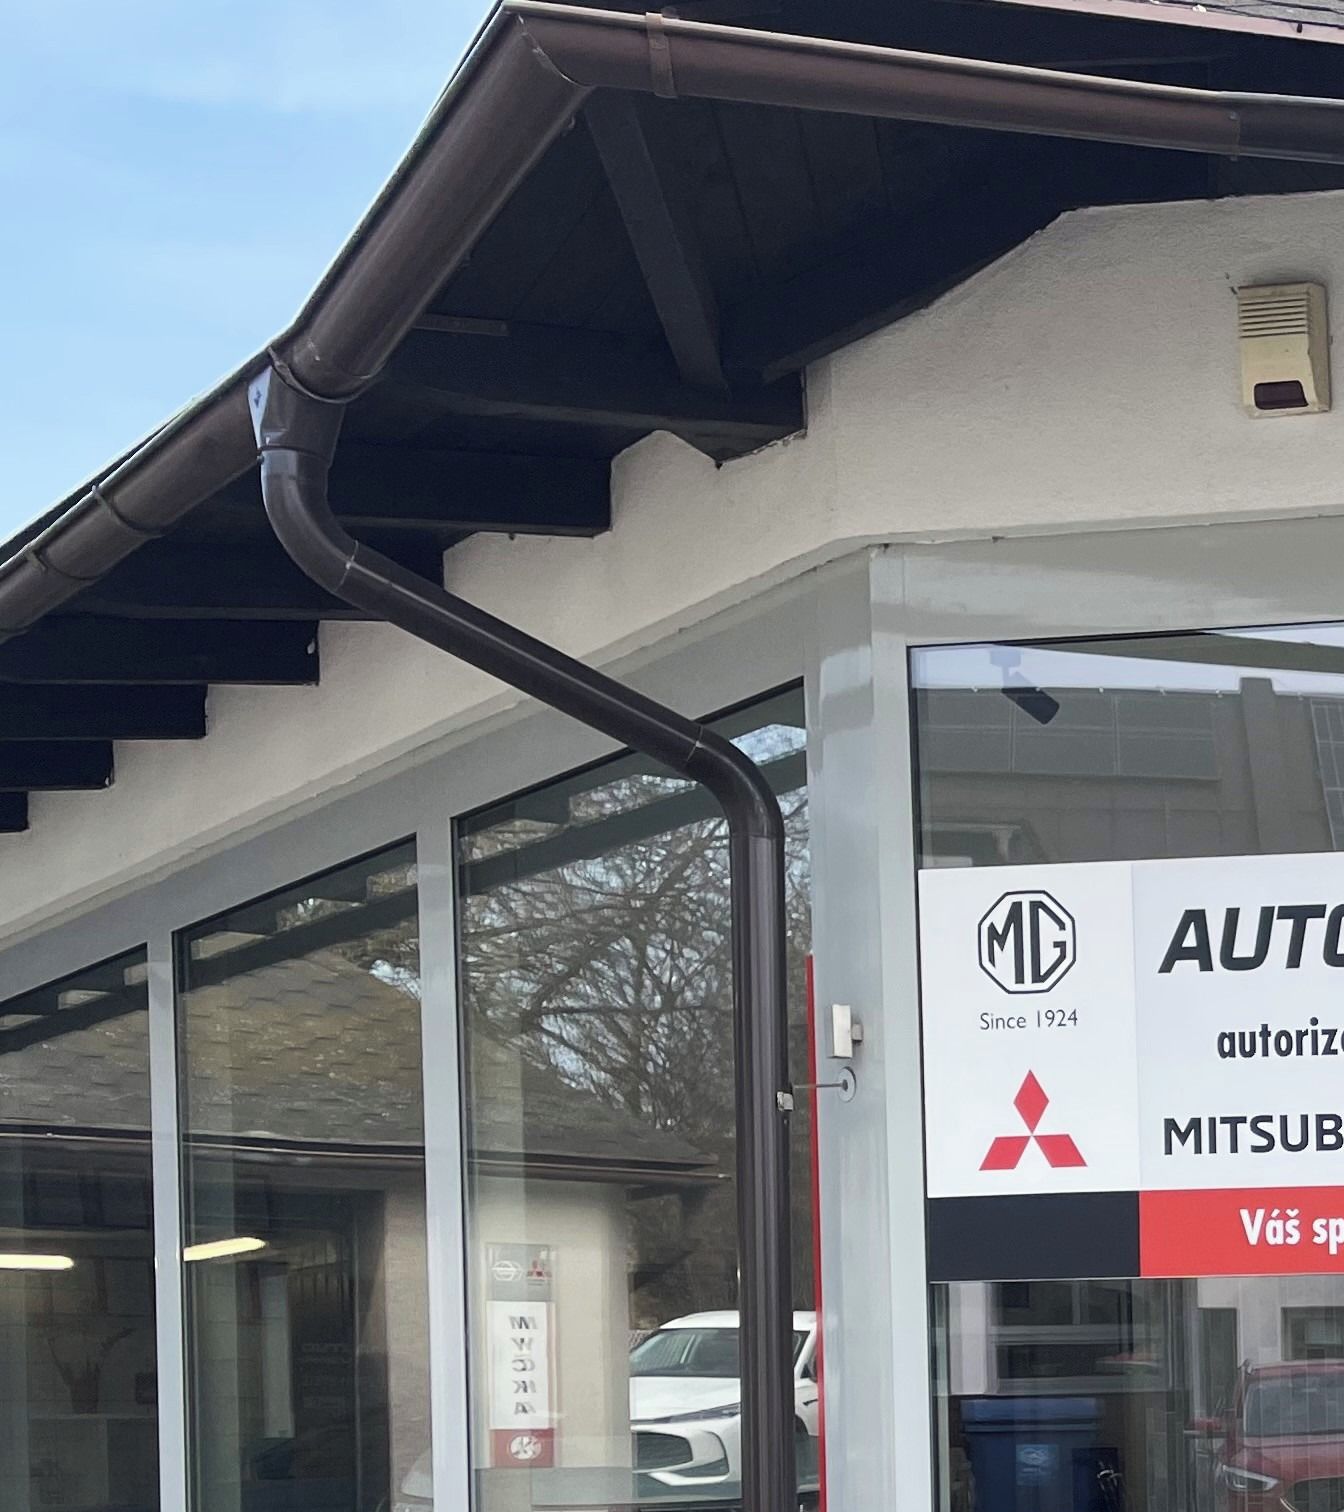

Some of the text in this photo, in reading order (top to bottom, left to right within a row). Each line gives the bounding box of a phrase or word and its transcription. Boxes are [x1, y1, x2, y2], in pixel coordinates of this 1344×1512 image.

[984, 902, 1068, 986] MG
[979, 1008, 1078, 1031] Since 1924
[1239, 1207, 1301, 1246] Váš
